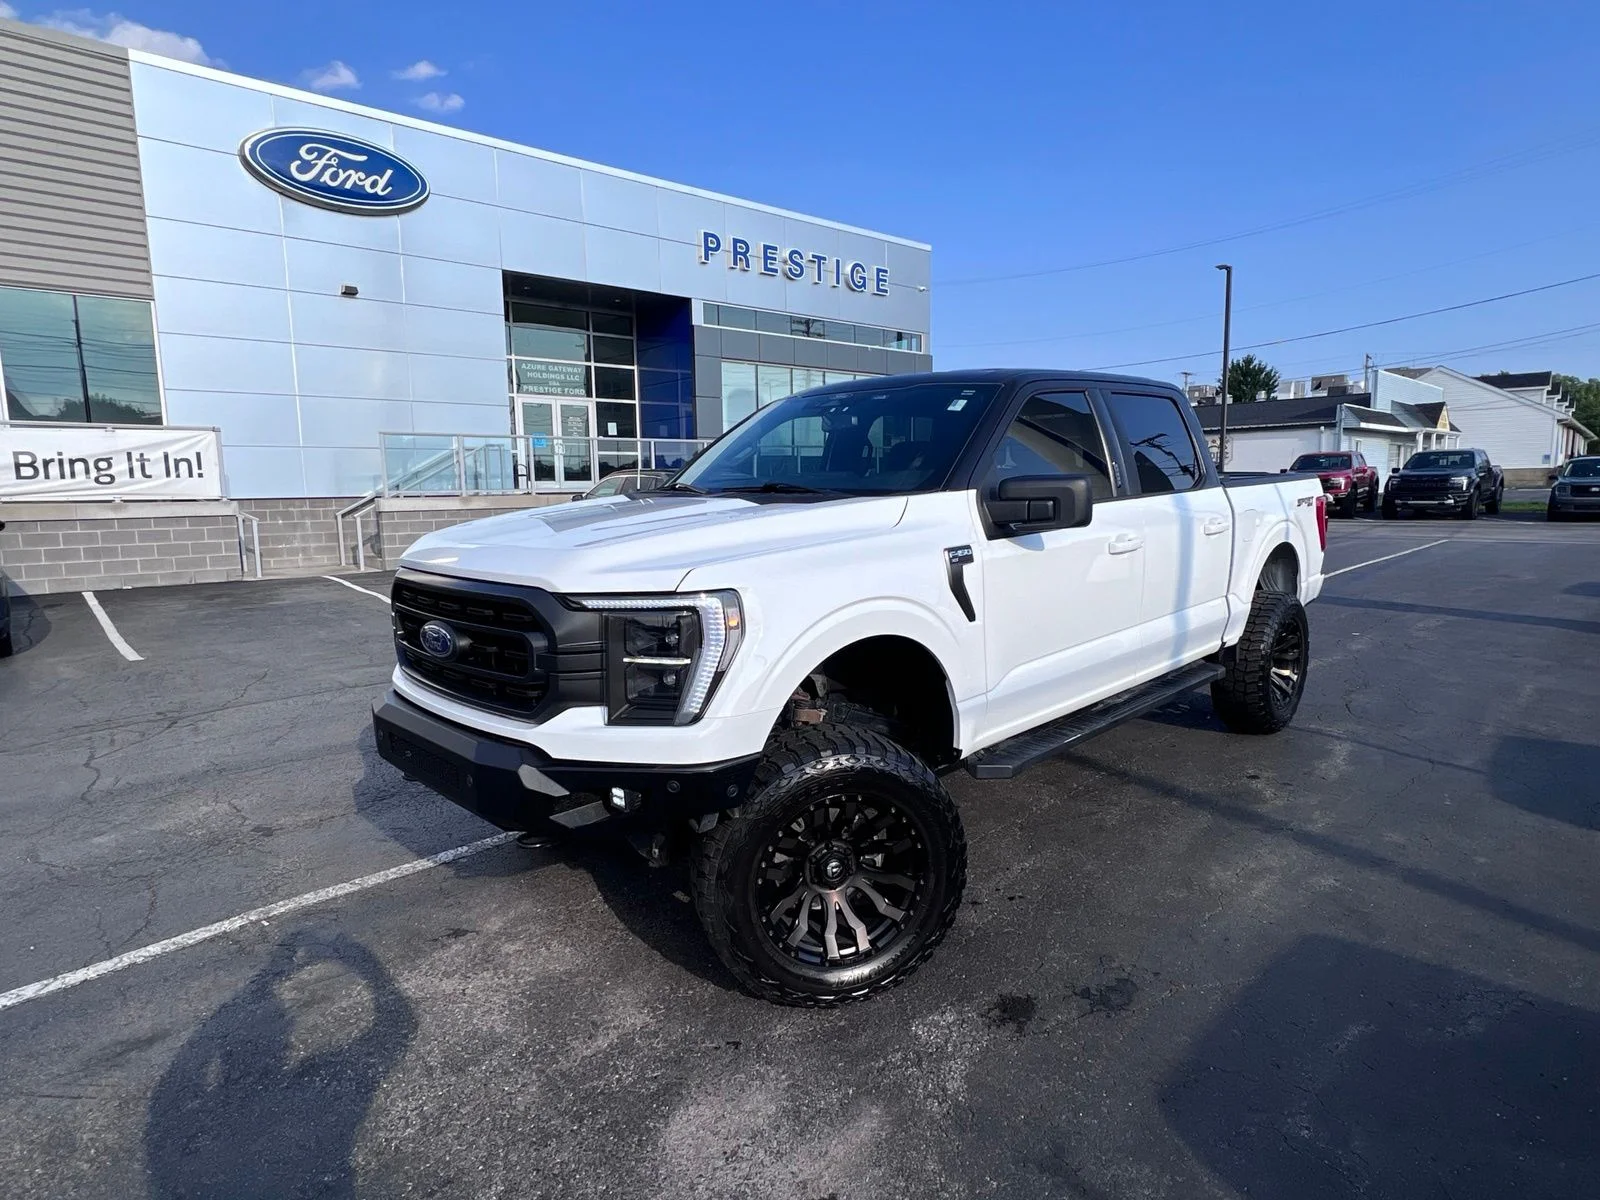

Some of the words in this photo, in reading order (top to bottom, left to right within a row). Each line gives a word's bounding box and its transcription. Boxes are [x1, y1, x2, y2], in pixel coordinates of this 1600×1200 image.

[290, 143, 393, 196] Ford
[699, 229, 890, 296] PRESTIGE
[527, 371, 565, 380] HOLDINGS
[548, 365, 582, 373] GATEWAY
[523, 385, 562, 394] PRESTIGE
[564, 388, 586, 396] FORD
[13, 451, 116, 486] Bring
[126, 451, 153, 479] It
[163, 451, 204, 479] In!
